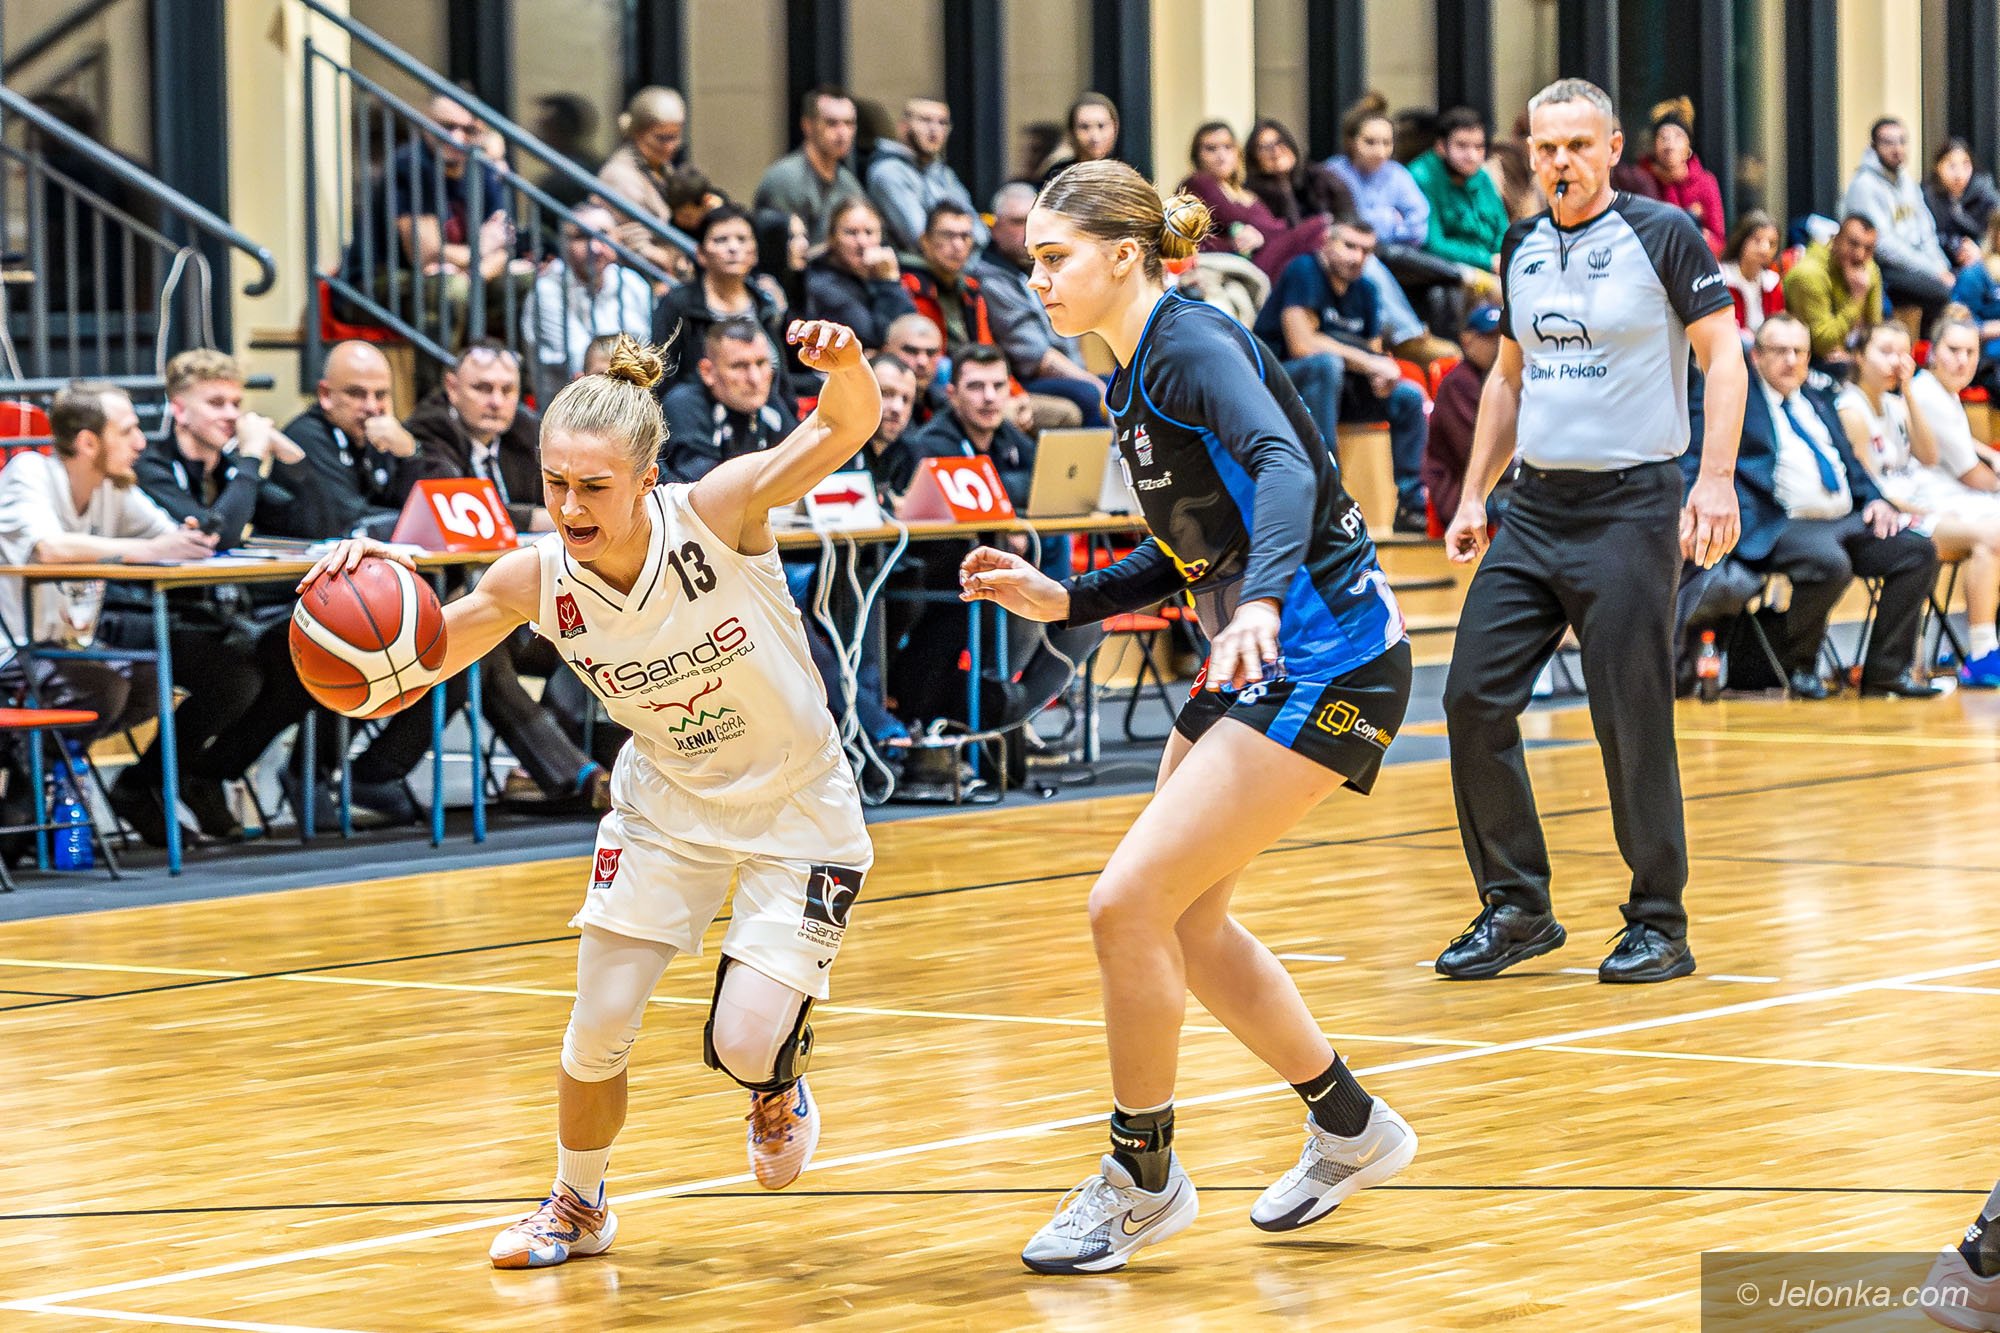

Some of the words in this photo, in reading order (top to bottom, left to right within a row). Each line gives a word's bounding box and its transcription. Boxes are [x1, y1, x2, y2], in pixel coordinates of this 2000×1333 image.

[1560, 362, 1607, 380] Pekao
[936, 468, 993, 512] 5
[432, 492, 496, 540] 5
[668, 541, 717, 602] 13
[603, 617, 747, 694] iSandS
[640, 670, 701, 694] enklawa
[702, 641, 755, 674] sportu
[714, 715, 746, 741] GÓRA
